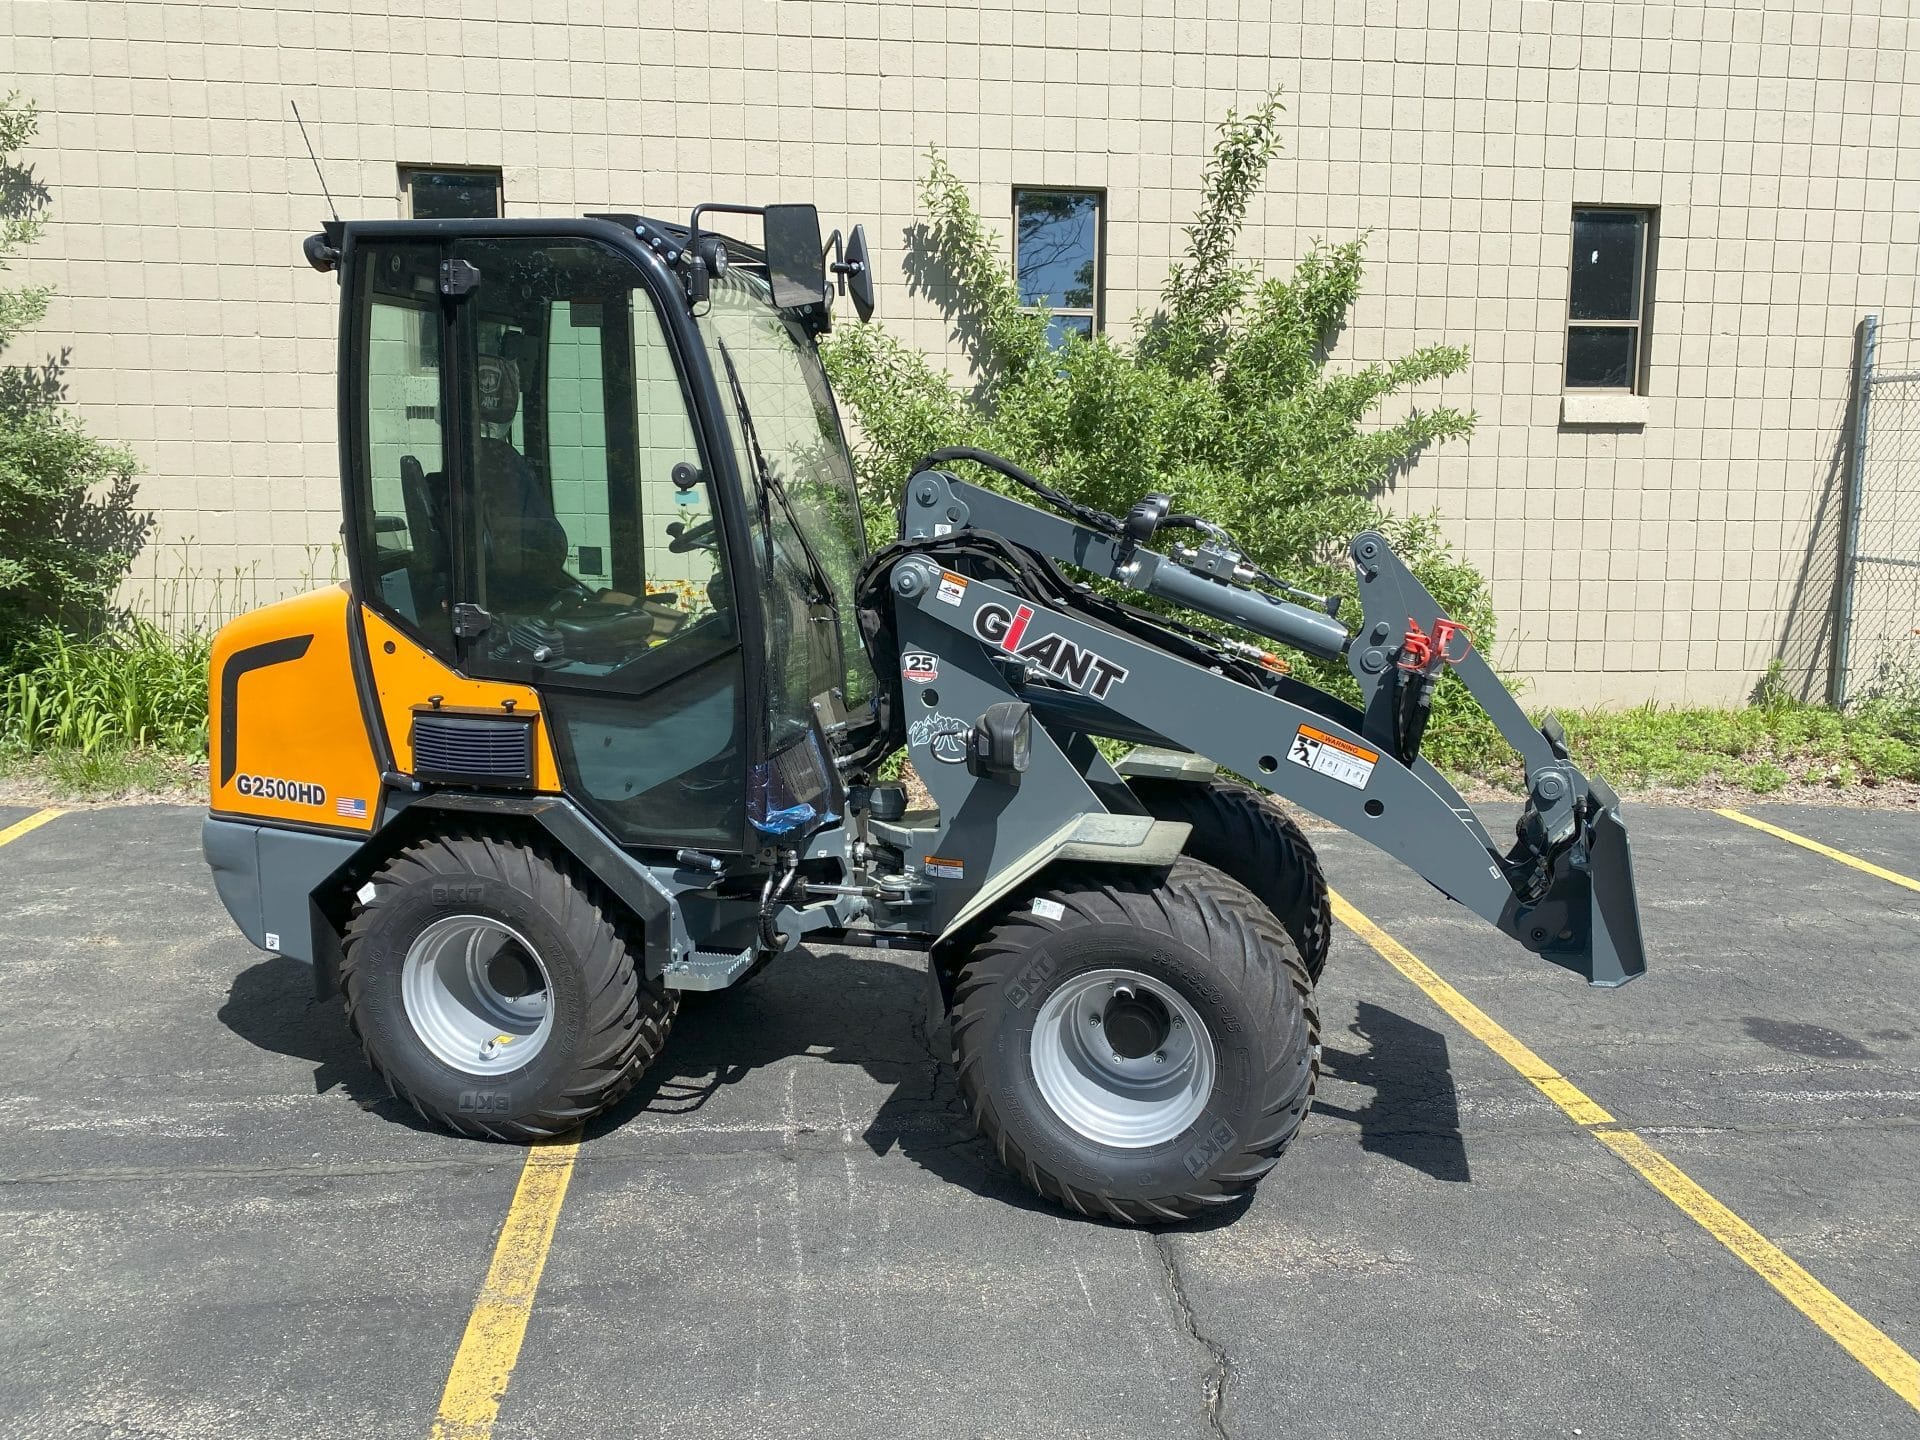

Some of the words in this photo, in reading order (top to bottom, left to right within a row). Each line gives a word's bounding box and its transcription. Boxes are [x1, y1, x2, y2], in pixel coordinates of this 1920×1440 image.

[909, 656, 933, 671] 25
[1325, 735, 1359, 754] WARNING
[236, 773, 326, 806] G2500HD
[432, 884, 484, 906] BKT
[1005, 946, 1056, 1008] BKT
[459, 1091, 511, 1114] BKT
[1183, 1117, 1238, 1180] BKT
